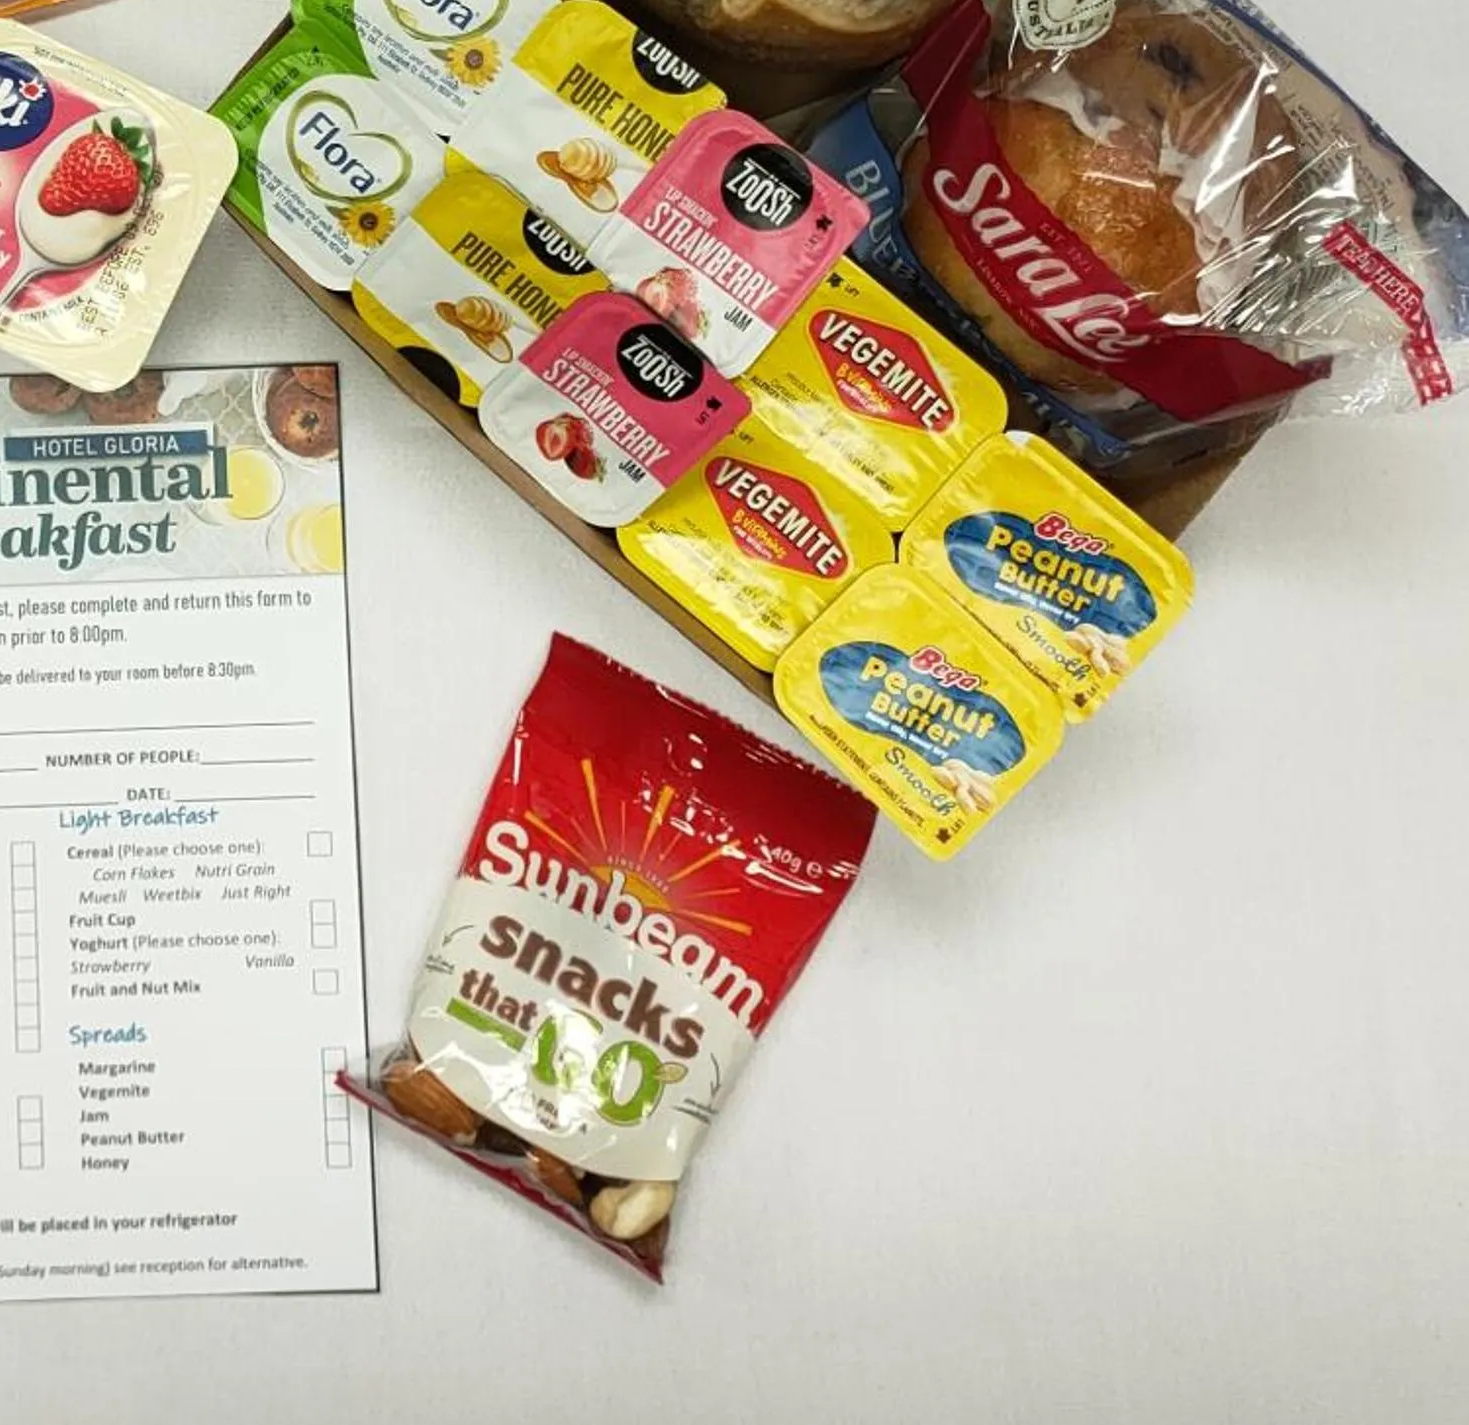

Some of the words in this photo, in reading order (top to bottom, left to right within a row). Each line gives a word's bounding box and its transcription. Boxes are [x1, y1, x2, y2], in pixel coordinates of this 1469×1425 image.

[556, 62, 623, 124] PURE
[298, 111, 377, 194] Flora
[452, 232, 515, 288] PURE
[644, 201, 778, 312] STRAWBERRY
[933, 162, 1081, 298] Sara
[1033, 293, 1150, 363] Lee
[723, 308, 753, 333] JAM
[818, 313, 950, 428] VEGEMITE
[542, 356, 670, 467] STRAWBERRY
[33, 438, 98, 457] HOTEL
[104, 434, 180, 454] GLORIA
[618, 458, 646, 484] JAM
[714, 459, 843, 574] VEGEMITE
[1035, 514, 1106, 555] Bega
[987, 525, 1124, 602] Peanut
[999, 561, 1090, 612] Butter
[18, 599, 66, 620] please
[70, 595, 138, 617] complete
[142, 594, 170, 612] and
[174, 593, 221, 612] return
[225, 591, 253, 610] this
[257, 590, 293, 608] form
[296, 590, 312, 607] to
[11, 629, 45, 649] prior
[51, 628, 65, 645] to
[1016, 615, 1090, 681] Smooth
[16, 667, 75, 685] delivered
[79, 668, 92, 682] to
[95, 669, 122, 684] your
[127, 666, 159, 681] room
[163, 663, 204, 679] before
[910, 646, 979, 691] Bega
[861, 656, 996, 739] Peanut
[870, 691, 961, 748] Butter
[46, 753, 111, 767] NUMBER
[117, 752, 135, 764] OF
[140, 750, 200, 764] PEOPLE:
[126, 788, 170, 801] DATE:
[885, 746, 956, 817] Smooth
[59, 809, 111, 834] Light
[118, 807, 218, 827] Breakfast
[67, 845, 114, 859] Cereal
[118, 843, 169, 860] (Please
[173, 842, 223, 856] choose
[92, 868, 125, 881] Corn
[131, 866, 175, 880] Flakes
[195, 864, 232, 878] Nutri
[236, 863, 275, 876] Grain
[79, 890, 127, 905] Muesli
[143, 888, 202, 902] Weetbix
[221, 886, 249, 900] Just
[253, 884, 291, 900] Right
[69, 914, 103, 928] Fruit
[107, 914, 136, 928] Cup
[478, 820, 764, 1029] Sunbeam
[69, 938, 128, 953] Yoghurt
[70, 959, 151, 974] Strawberry
[245, 955, 295, 968] Vanilla
[71, 984, 106, 998] Fruit
[110, 982, 137, 996] and
[142, 982, 169, 994] Nut
[173, 980, 201, 993] Mix
[460, 968, 538, 1032] that
[480, 914, 705, 1059] snacks
[69, 1023, 147, 1047] Spreads
[79, 1061, 156, 1077] Margarine
[79, 1085, 150, 1101] Vegemite
[79, 1110, 109, 1123] Jam
[81, 1132, 133, 1147] Peanut
[137, 1131, 185, 1145] Butter
[81, 1156, 130, 1171] Honey
